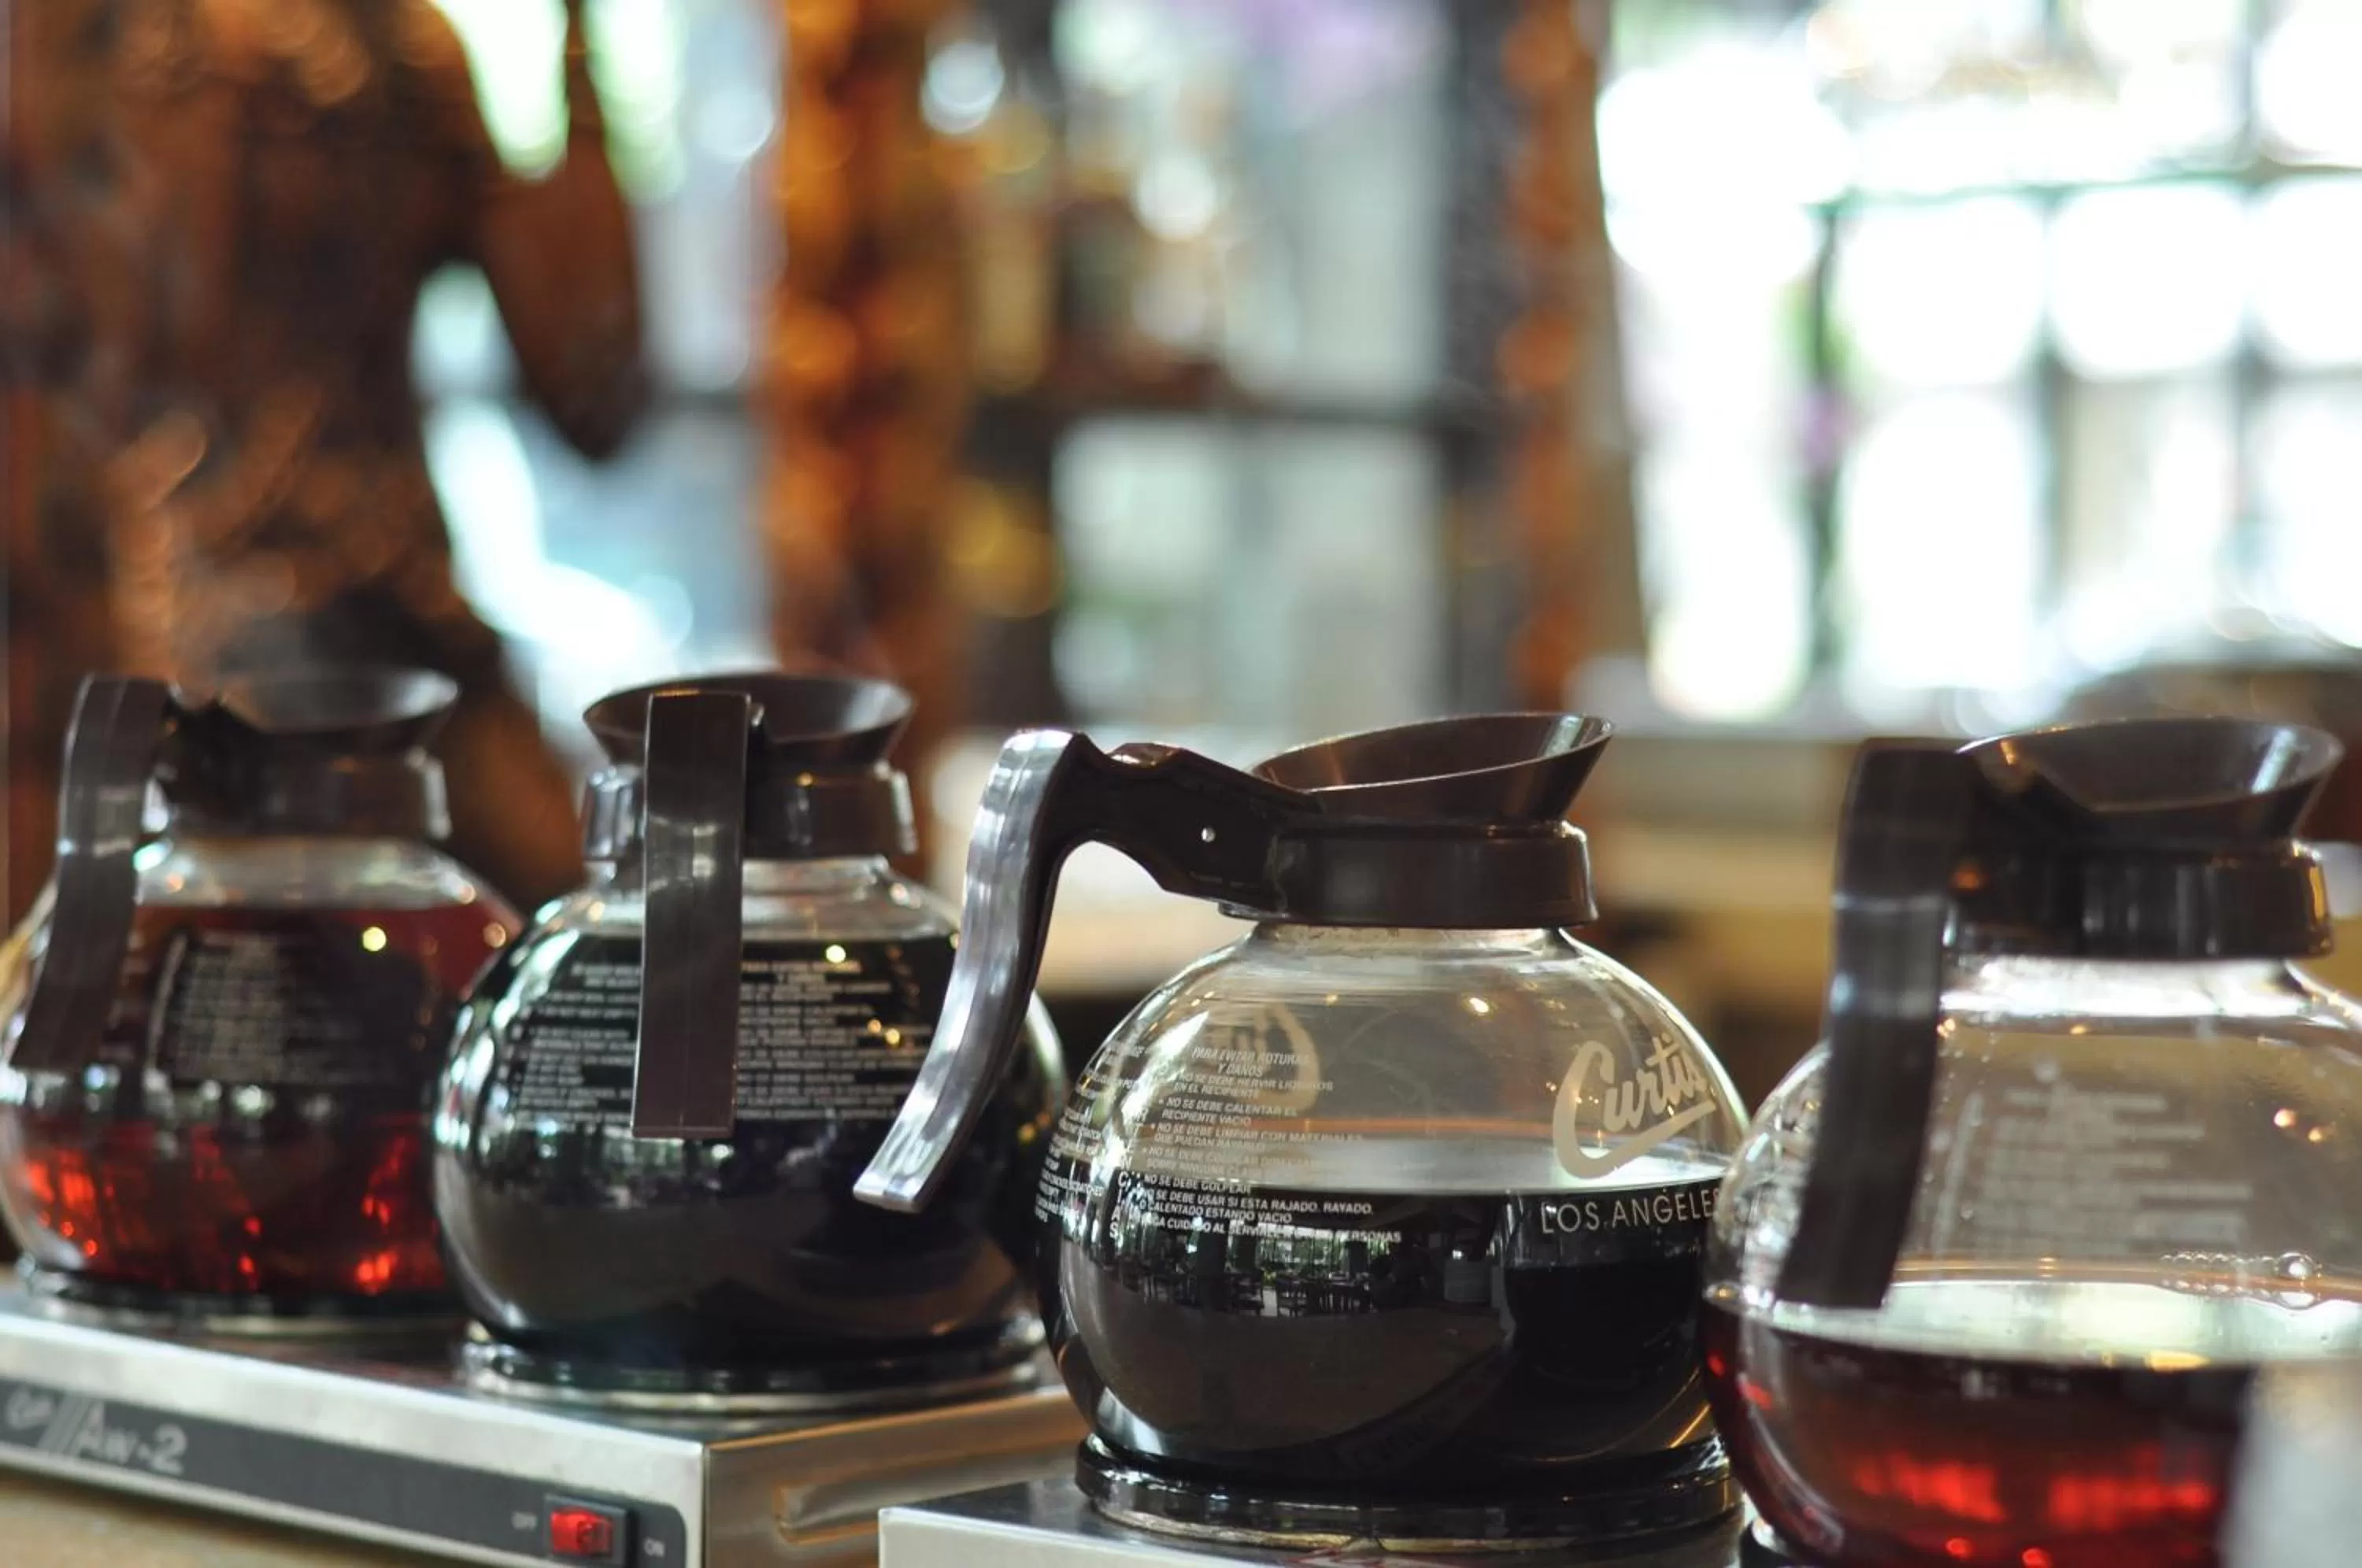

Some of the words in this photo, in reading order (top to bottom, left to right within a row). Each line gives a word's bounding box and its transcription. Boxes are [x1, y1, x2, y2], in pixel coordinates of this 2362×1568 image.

[1191, 1046, 1218, 1060] PARA
[1217, 1063, 1226, 1074] Y
[1279, 1079, 1334, 1092] LIQDOS
[1166, 1096, 1182, 1108] NO
[1183, 1098, 1195, 1110] SE
[1196, 1099, 1223, 1112] DEBE
[1224, 1103, 1282, 1115] CALENTAR
[1553, 1034, 1716, 1179] Curtis
[1161, 1108, 1217, 1123] RECIPIENTE
[1220, 1115, 1253, 1127] VACIO
[1153, 1132, 1172, 1144] QUE
[1157, 1121, 1172, 1133] NO
[1173, 1123, 1185, 1134] SE
[1187, 1124, 1215, 1137] DEBE
[1143, 1174, 1158, 1185] NO
[1158, 1176, 1172, 1187] SE
[1172, 1178, 1200, 1190] DEBE
[1201, 1181, 1252, 1196] GOLPEAR
[1155, 1189, 1169, 1201] SE
[1169, 1191, 1196, 1204] DEBE
[1198, 1194, 1227, 1208] USAR
[1227, 1197, 1238, 1208] SI
[1240, 1198, 1268, 1211] ESTA
[1148, 1200, 1204, 1217] CALENTADO
[1205, 1207, 1256, 1222] ESTANDO
[1257, 1211, 1293, 1224] VACIO
[1541, 1201, 1601, 1234] LOS
[1167, 1218, 1212, 1233] CUIDO
[1212, 1221, 1226, 1233] AL
